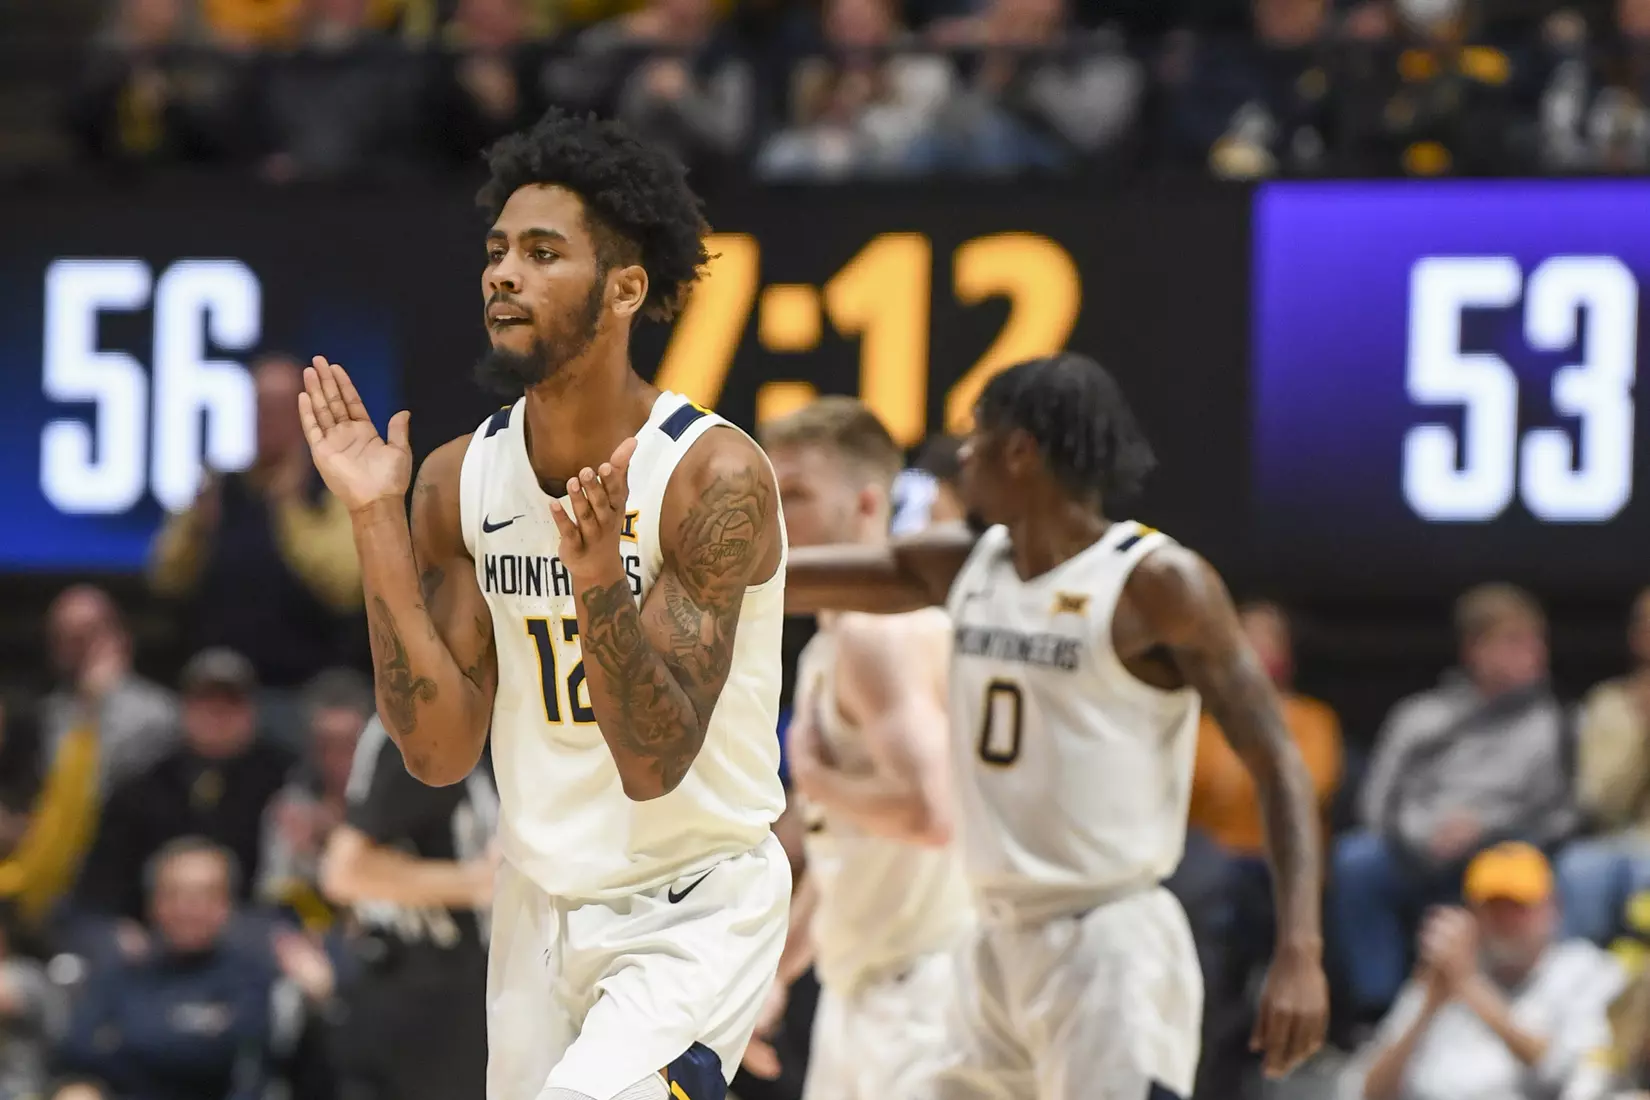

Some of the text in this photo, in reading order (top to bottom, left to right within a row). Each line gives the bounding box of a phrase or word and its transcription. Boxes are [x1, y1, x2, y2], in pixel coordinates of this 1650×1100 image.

[41, 257, 262, 514] 56
[655, 231, 1083, 447] 7:12
[1403, 255, 1639, 522] 53
[976, 675, 1024, 768] 0
